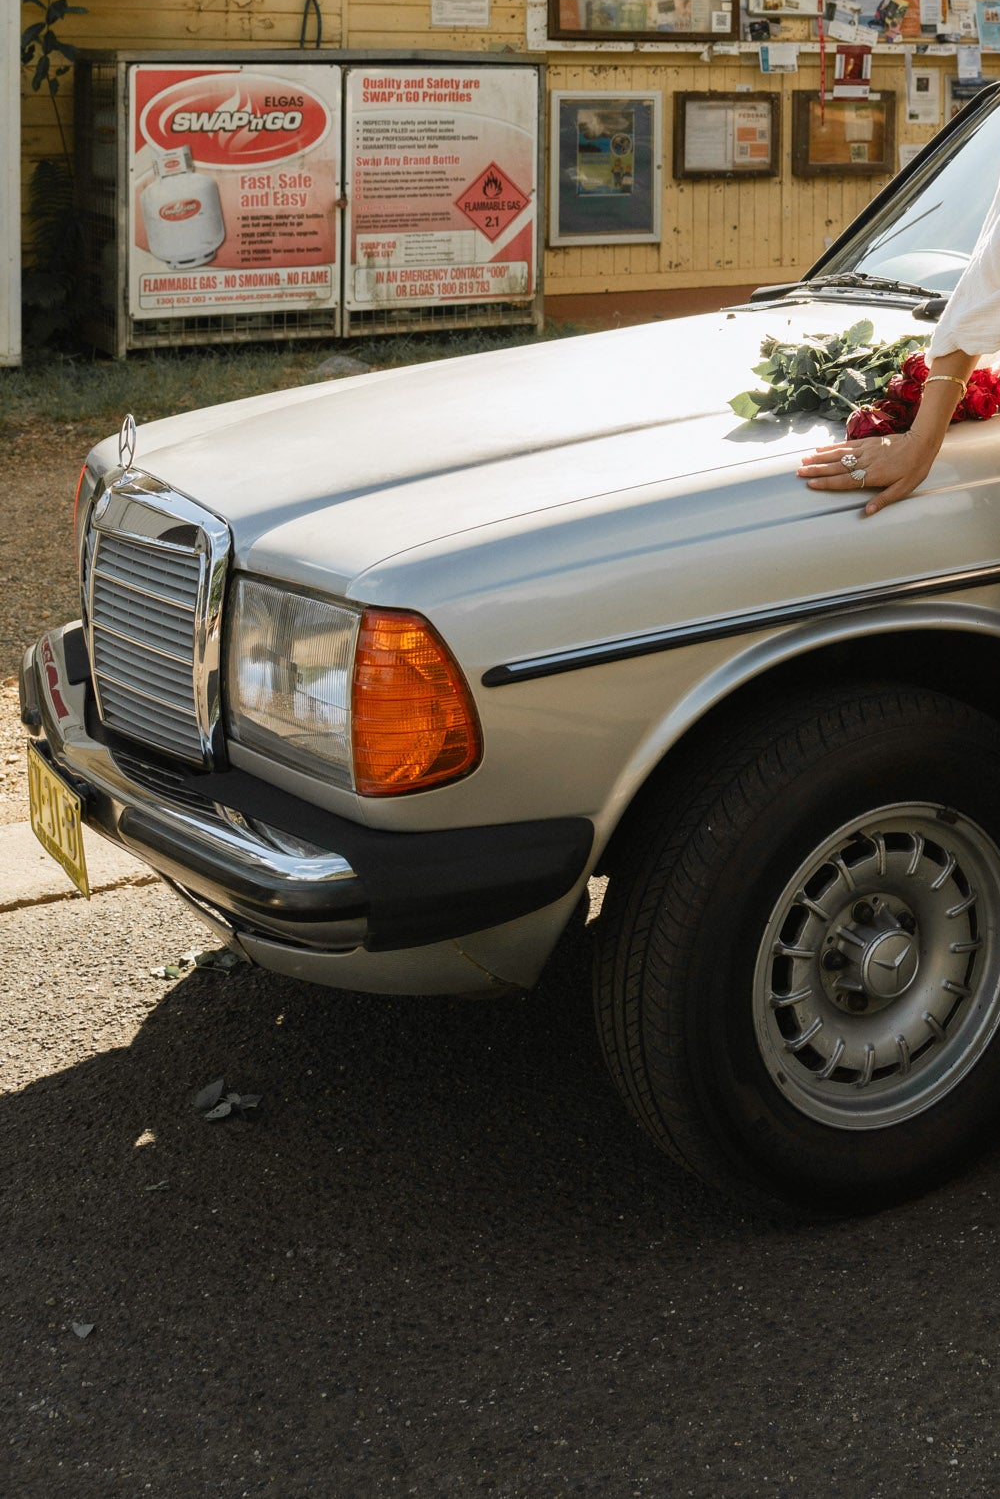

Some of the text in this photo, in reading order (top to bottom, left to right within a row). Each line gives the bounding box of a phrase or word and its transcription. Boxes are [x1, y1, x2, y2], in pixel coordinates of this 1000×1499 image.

[363, 78, 480, 90] Quality and Safety are
[264, 96, 304, 108] ELGAS
[422, 91, 472, 102] Priorities
[171, 111, 303, 133] SWAP'n'GO
[356, 155, 460, 167] Swap Any Brand Bottle
[278, 173, 312, 189] Safe
[241, 191, 307, 207] and Easy
[464, 201, 521, 212] FLAMMABLE GAS
[485, 216, 499, 228] 2.1
[143, 277, 198, 293] FLAMMABLE
[200, 276, 217, 290] GAS
[224, 275, 237, 288] NO
[239, 272, 280, 287] SMOKING
[287, 272, 298, 286] NO
[302, 270, 329, 285] FLAME
[376, 272, 384, 284] IN
[386, 270, 398, 283] AN
[400, 268, 448, 282] EMERGENCY
[451, 266, 485, 280] CONTACT
[396, 280, 490, 297] OR ELGAS 1800 819 783
